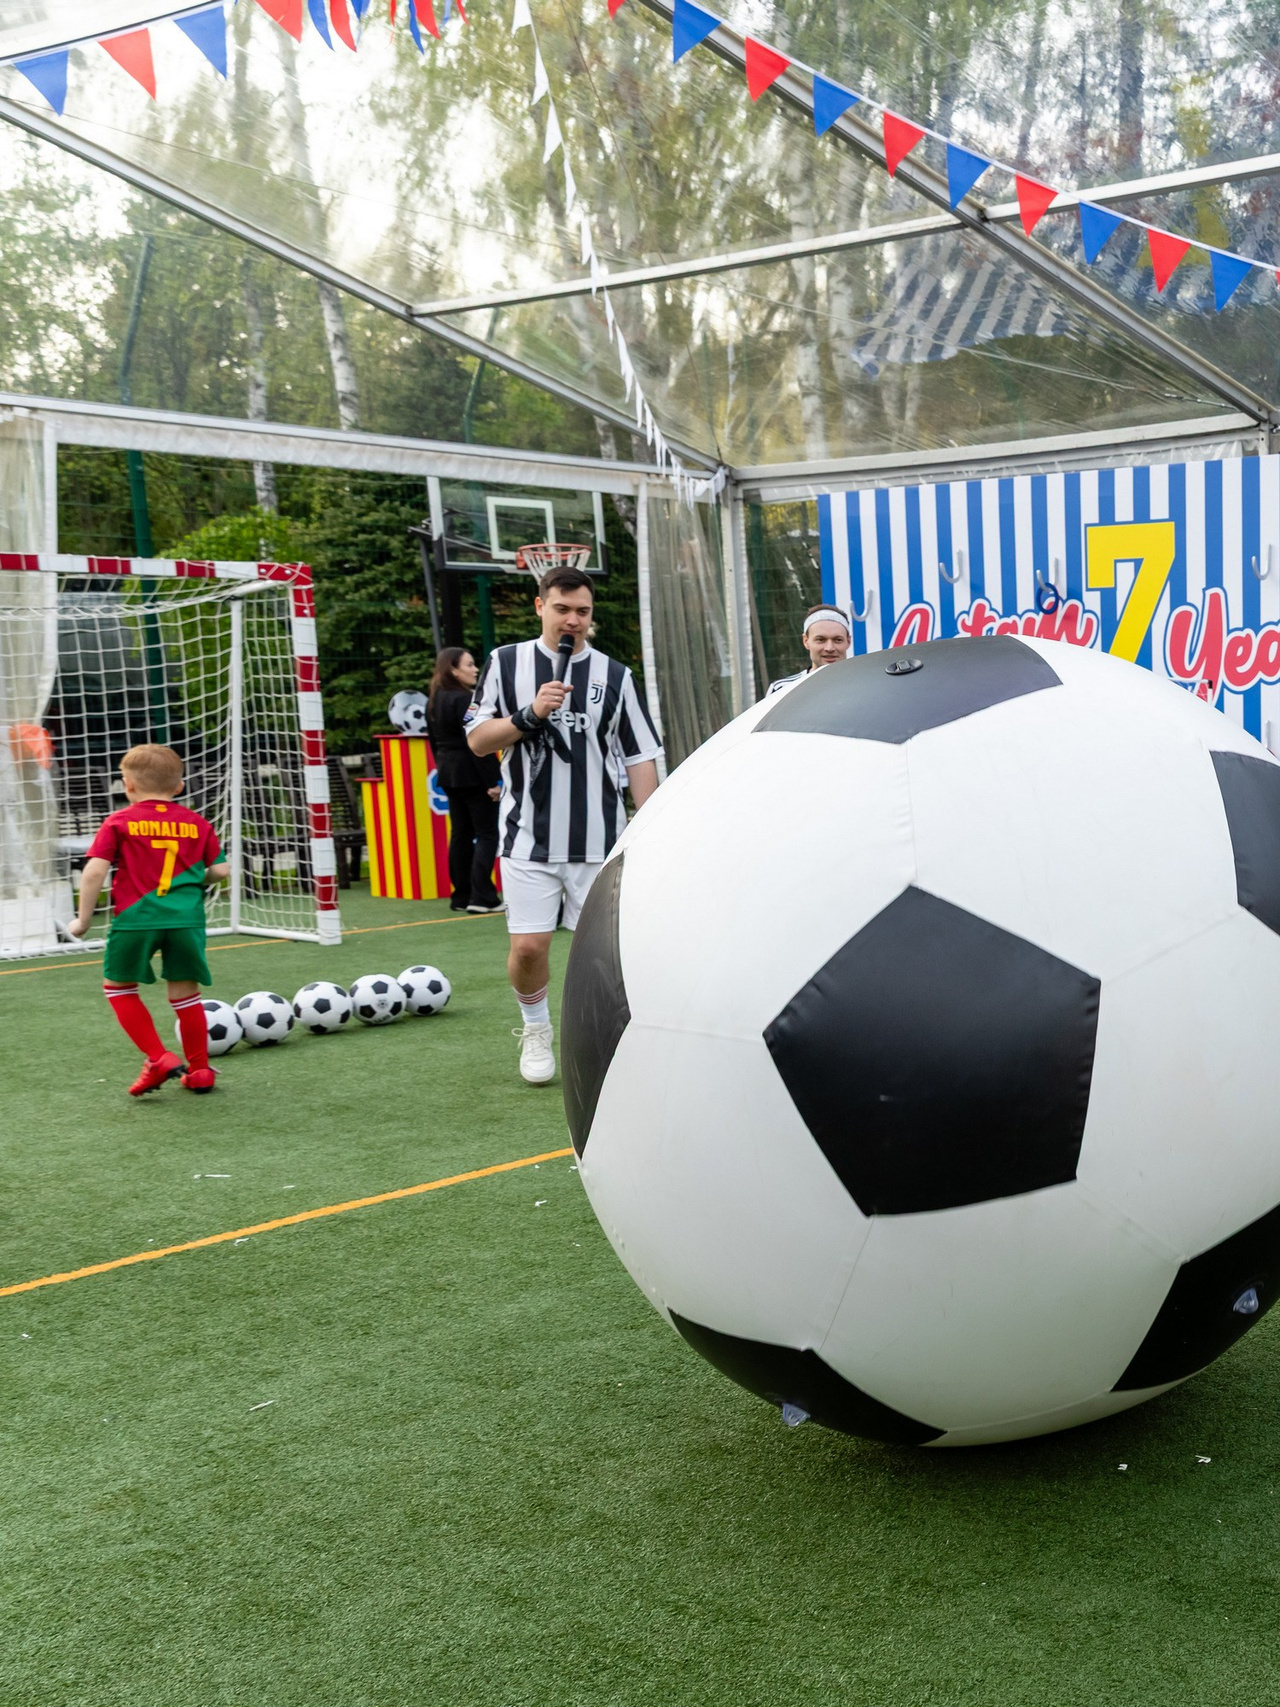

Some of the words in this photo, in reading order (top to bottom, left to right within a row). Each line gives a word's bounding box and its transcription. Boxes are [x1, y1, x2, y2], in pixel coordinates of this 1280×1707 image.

[1086, 521, 1176, 664] 7
[549, 709, 592, 733] eep
[127, 820, 199, 839] RONALDO
[150, 839, 179, 898] 7
